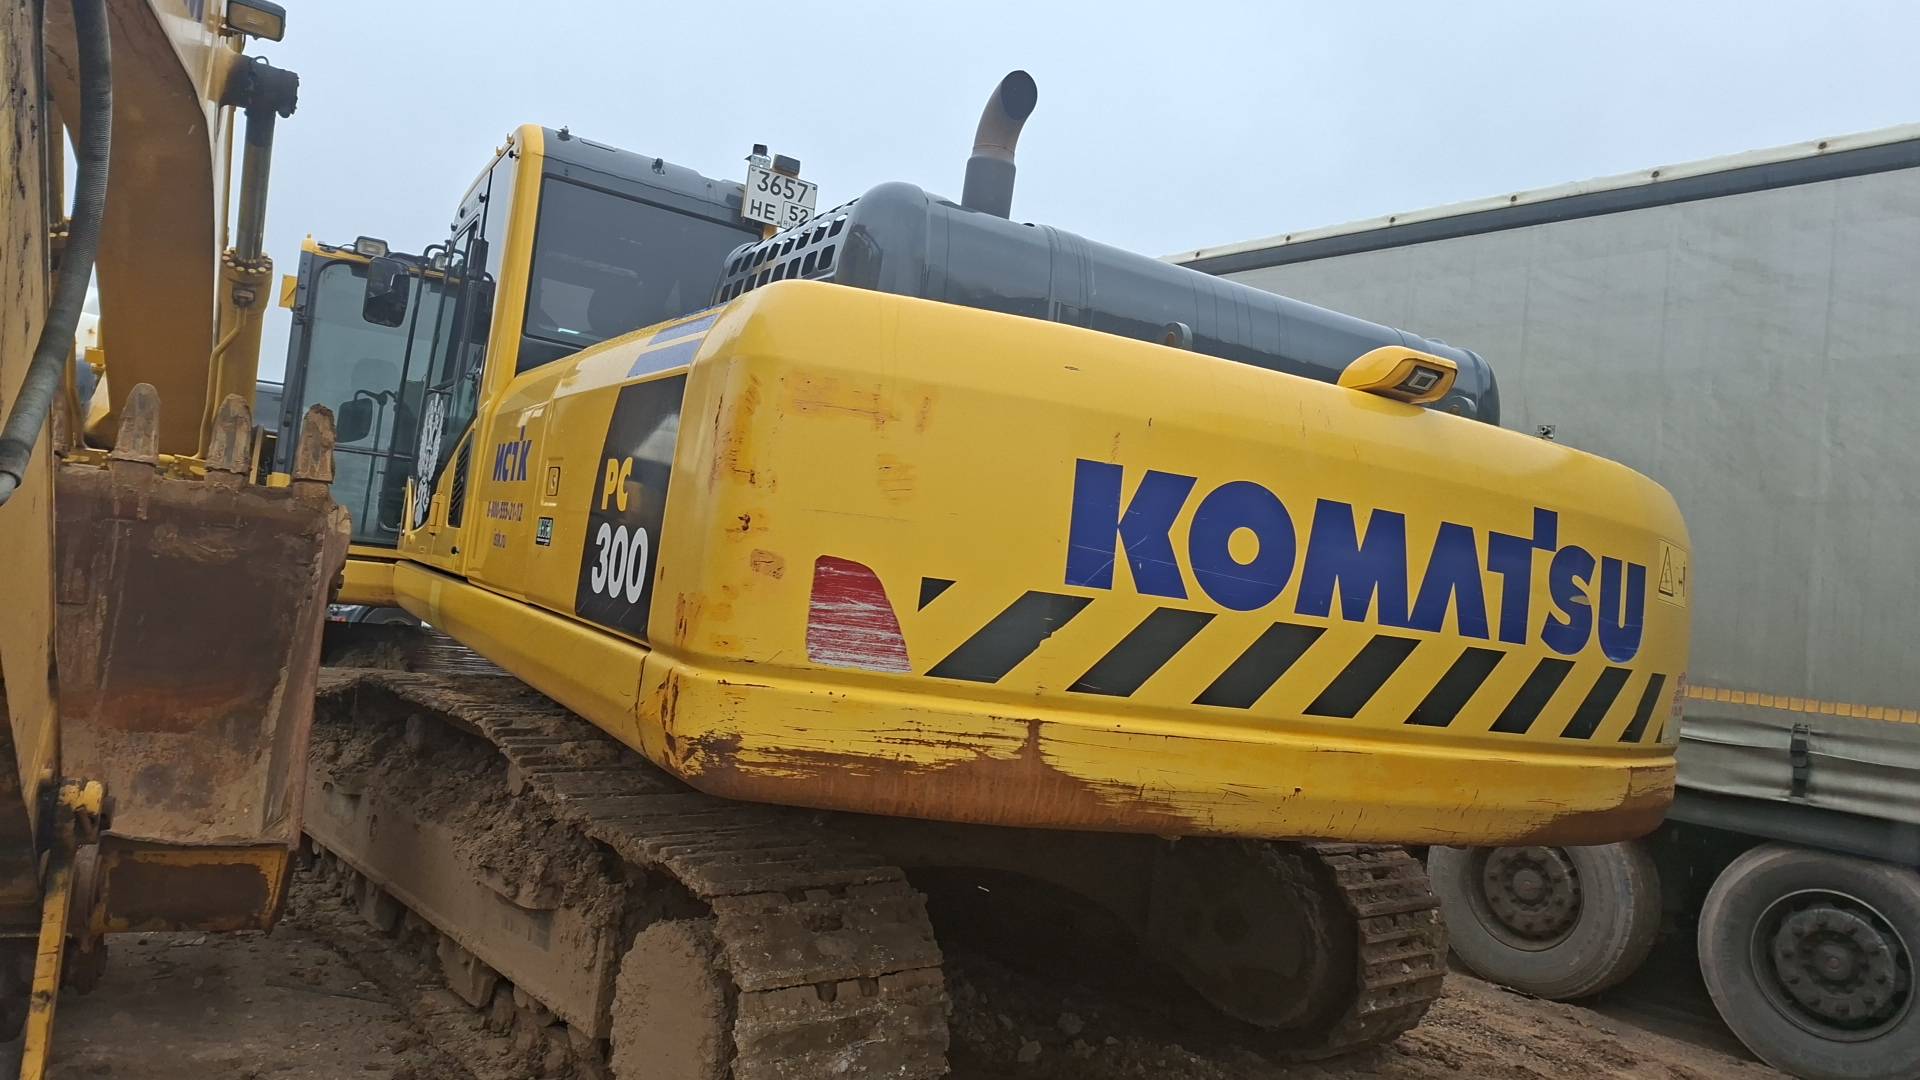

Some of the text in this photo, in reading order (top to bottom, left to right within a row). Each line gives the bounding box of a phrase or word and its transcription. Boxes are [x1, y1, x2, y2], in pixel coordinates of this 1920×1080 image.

[757, 170, 809, 203] 3657
[788, 205, 809, 223] 52
[601, 456, 633, 512] PC
[591, 522, 649, 604] 300
[1064, 458, 1647, 663] KOMATSU
